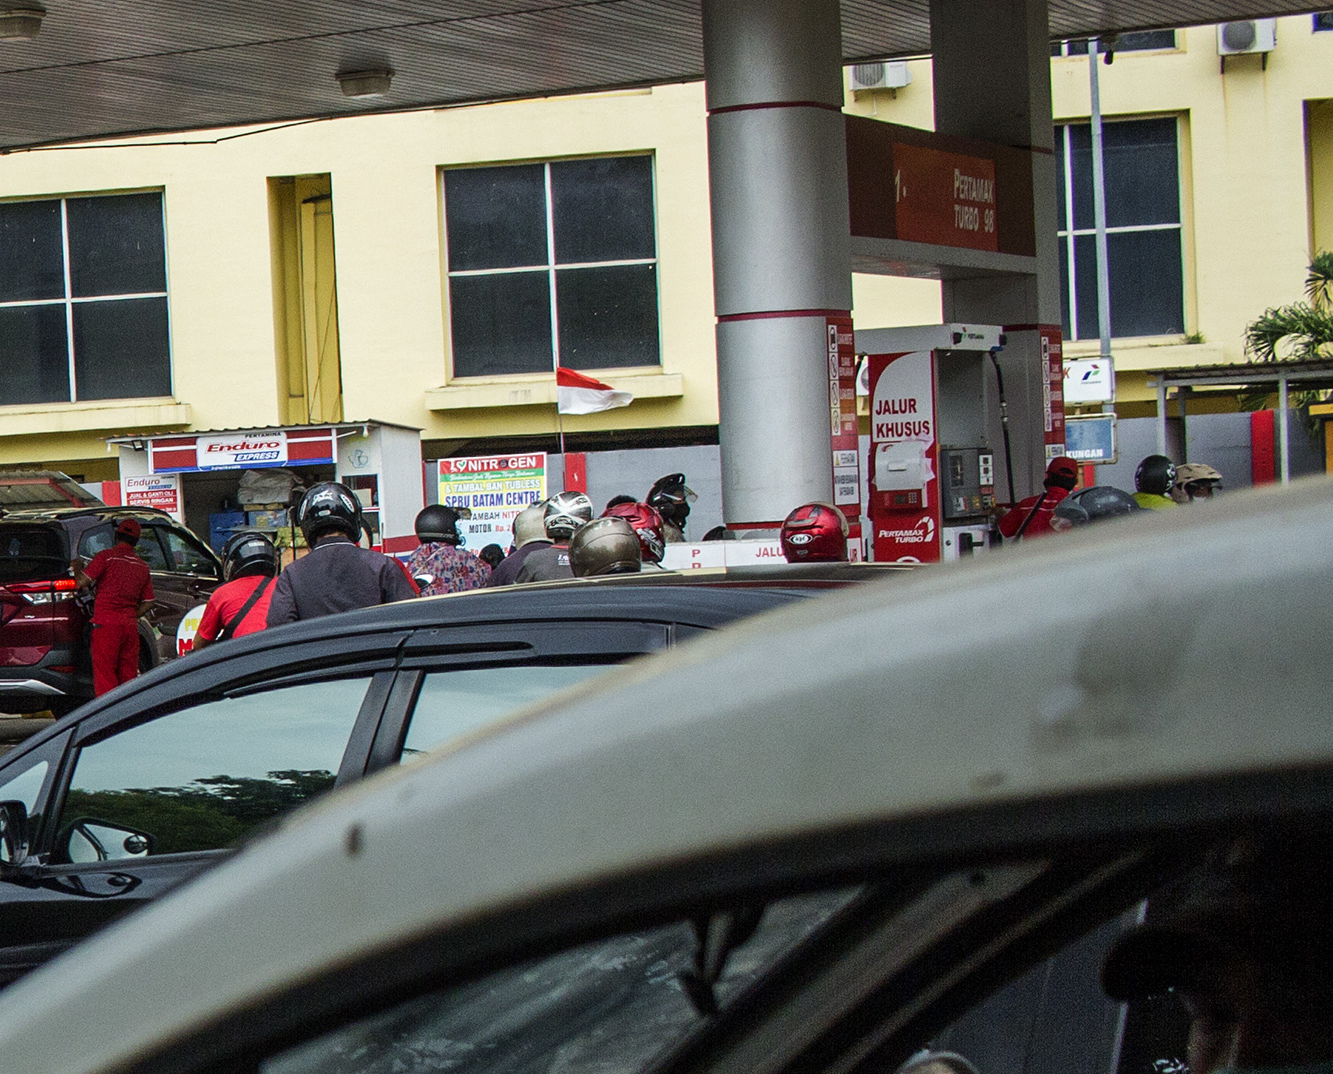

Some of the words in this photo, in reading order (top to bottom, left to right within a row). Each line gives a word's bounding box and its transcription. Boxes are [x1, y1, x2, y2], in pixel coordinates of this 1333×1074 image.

[953, 168, 994, 204] PERTAMAX
[954, 204, 979, 231] TURBO
[984, 208, 994, 233] 98
[875, 398, 917, 415] JALUR
[876, 420, 930, 438] KHUSUS
[207, 441, 280, 453] Enduro
[236, 452, 277, 460] EXPRESS
[127, 479, 160, 487] Enduro
[454, 482, 484, 493] TAMBAL
[486, 481, 503, 490] BAN
[505, 478, 540, 489] TUBLESS
[445, 494, 470, 508] SPBU
[473, 493, 504, 507] BATAM
[878, 529, 924, 538] PERTAMAX
[895, 536, 924, 544] TURBO
